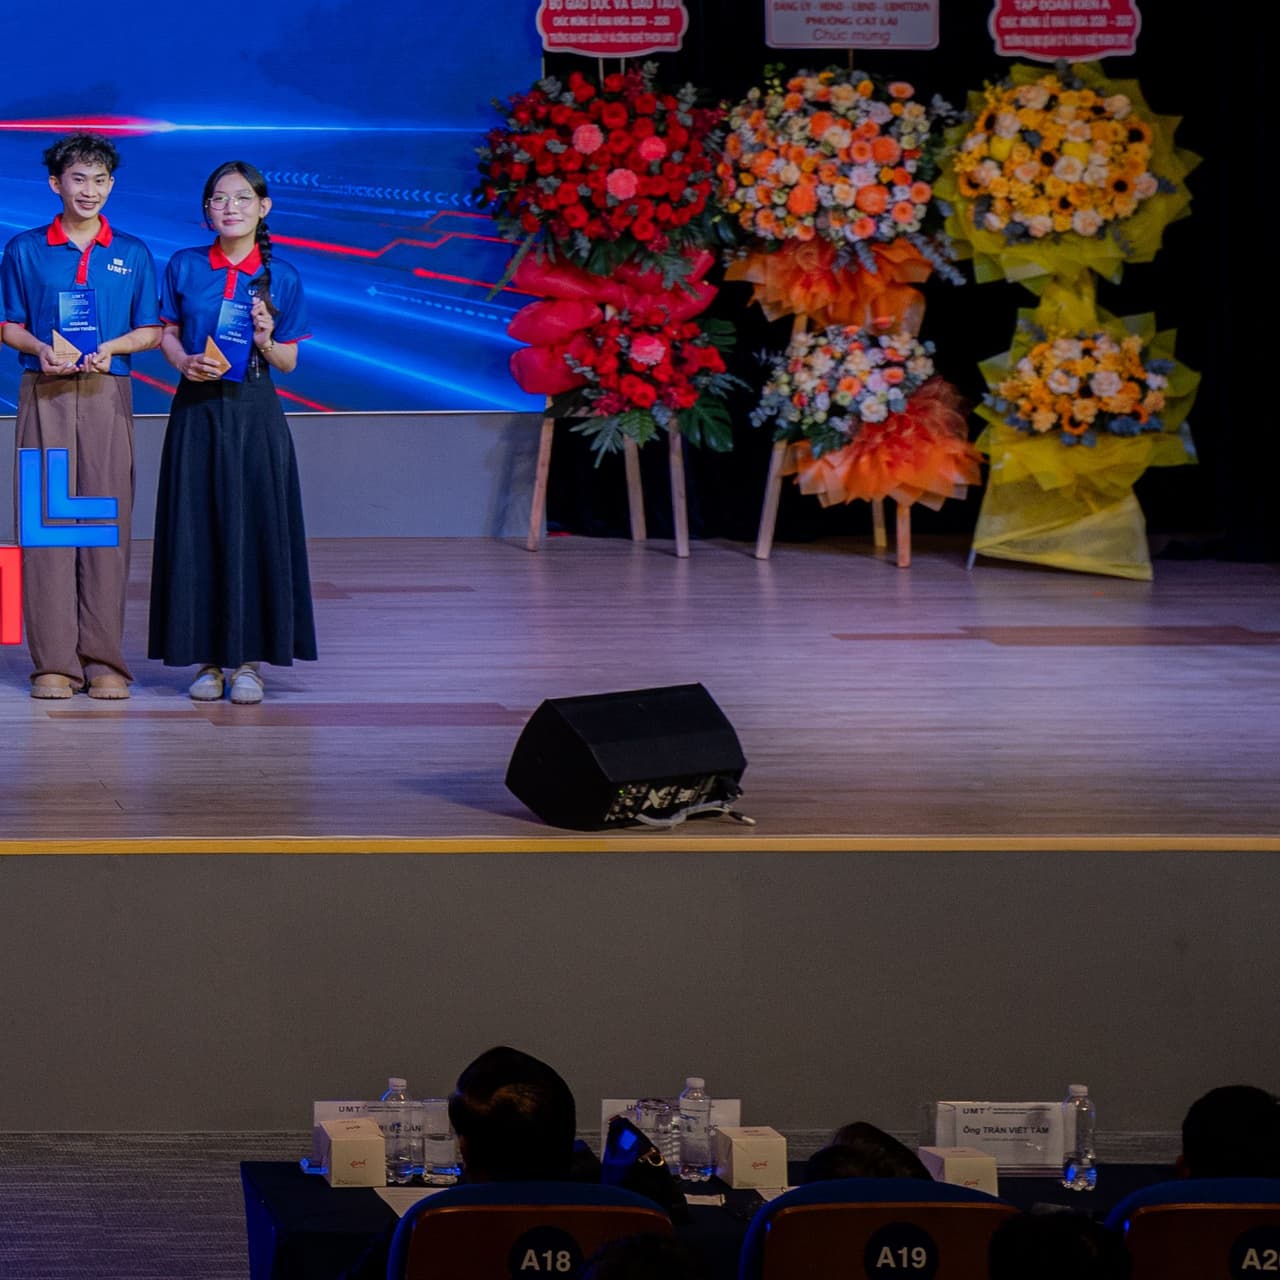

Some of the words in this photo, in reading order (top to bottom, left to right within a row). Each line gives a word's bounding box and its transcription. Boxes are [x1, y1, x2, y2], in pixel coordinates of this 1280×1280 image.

[107, 263, 128, 275] UMT
[520, 1250, 571, 1272] A18
[876, 1247, 927, 1269] A19
[1241, 1248, 1280, 1270] A2
